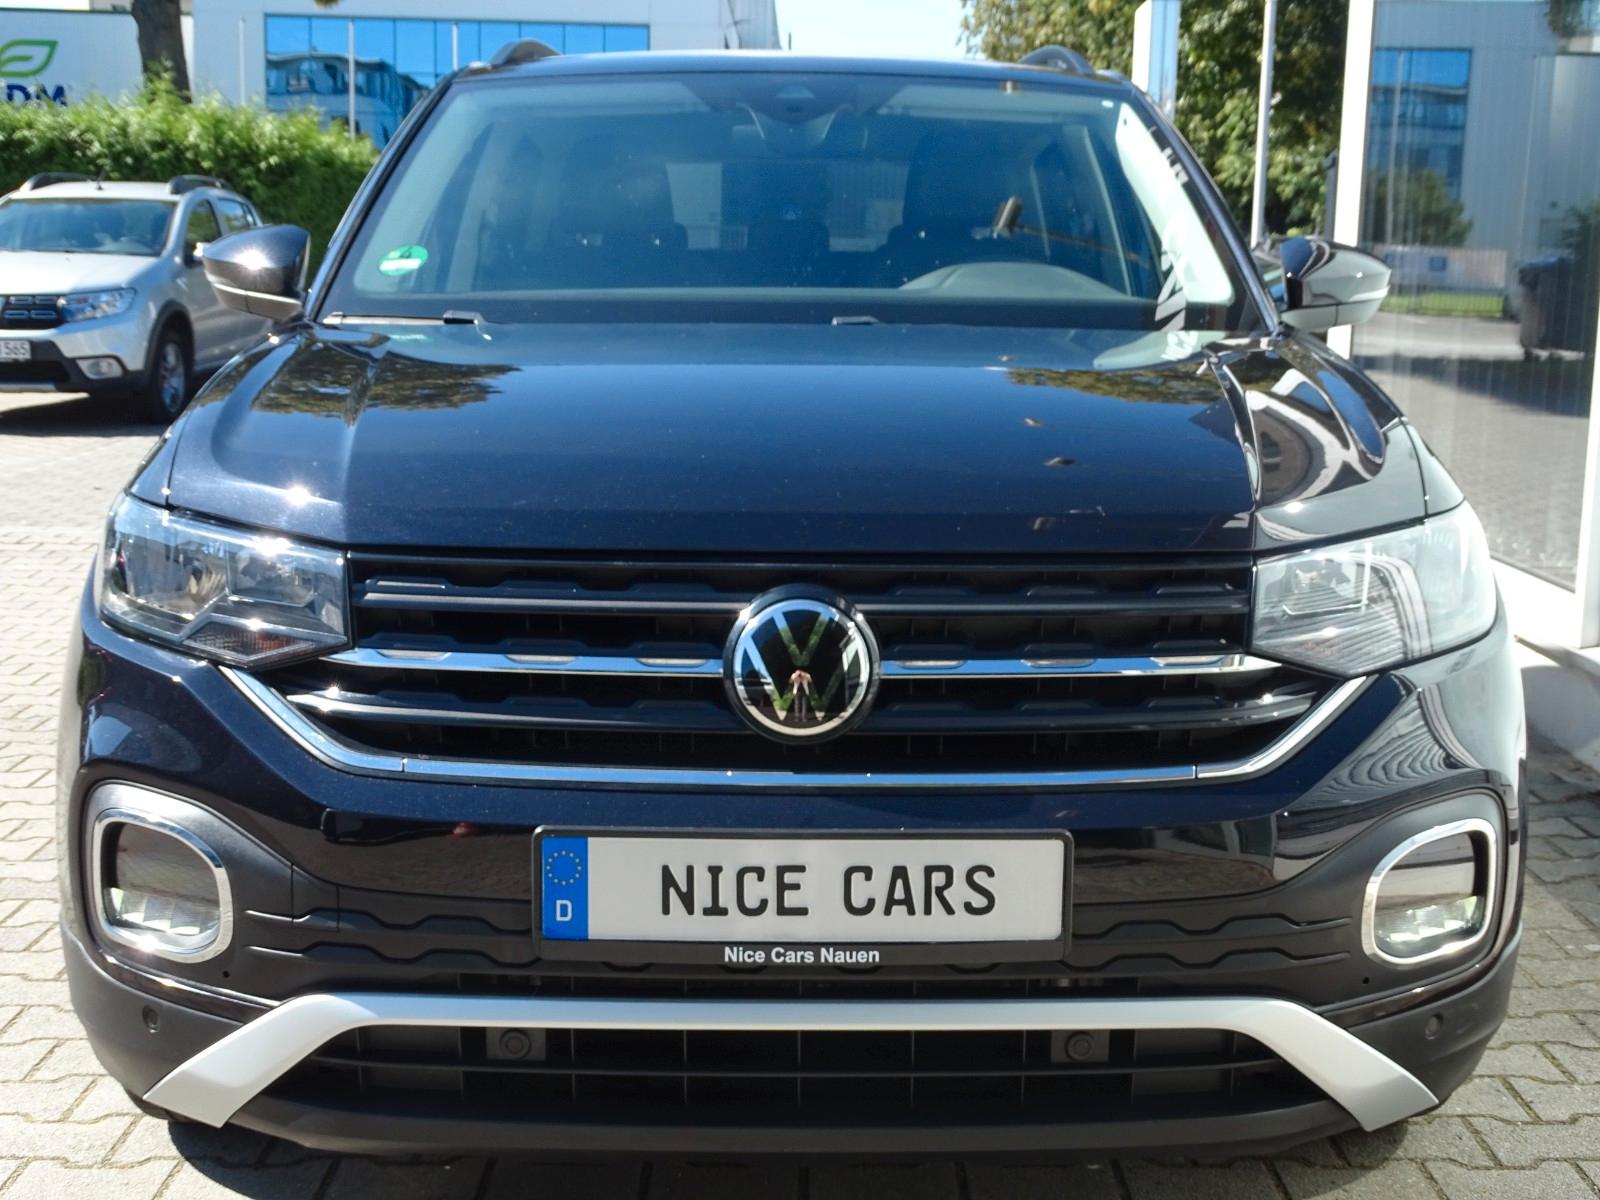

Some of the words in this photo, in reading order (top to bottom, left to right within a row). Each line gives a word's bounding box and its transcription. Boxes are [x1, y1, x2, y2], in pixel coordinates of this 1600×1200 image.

[661, 864, 809, 917] NICE
[843, 864, 996, 917] CARS
[555, 899, 573, 922] D
[724, 946, 766, 963] Nice
[770, 947, 815, 964] Cars
[820, 947, 880, 963] Nauen
